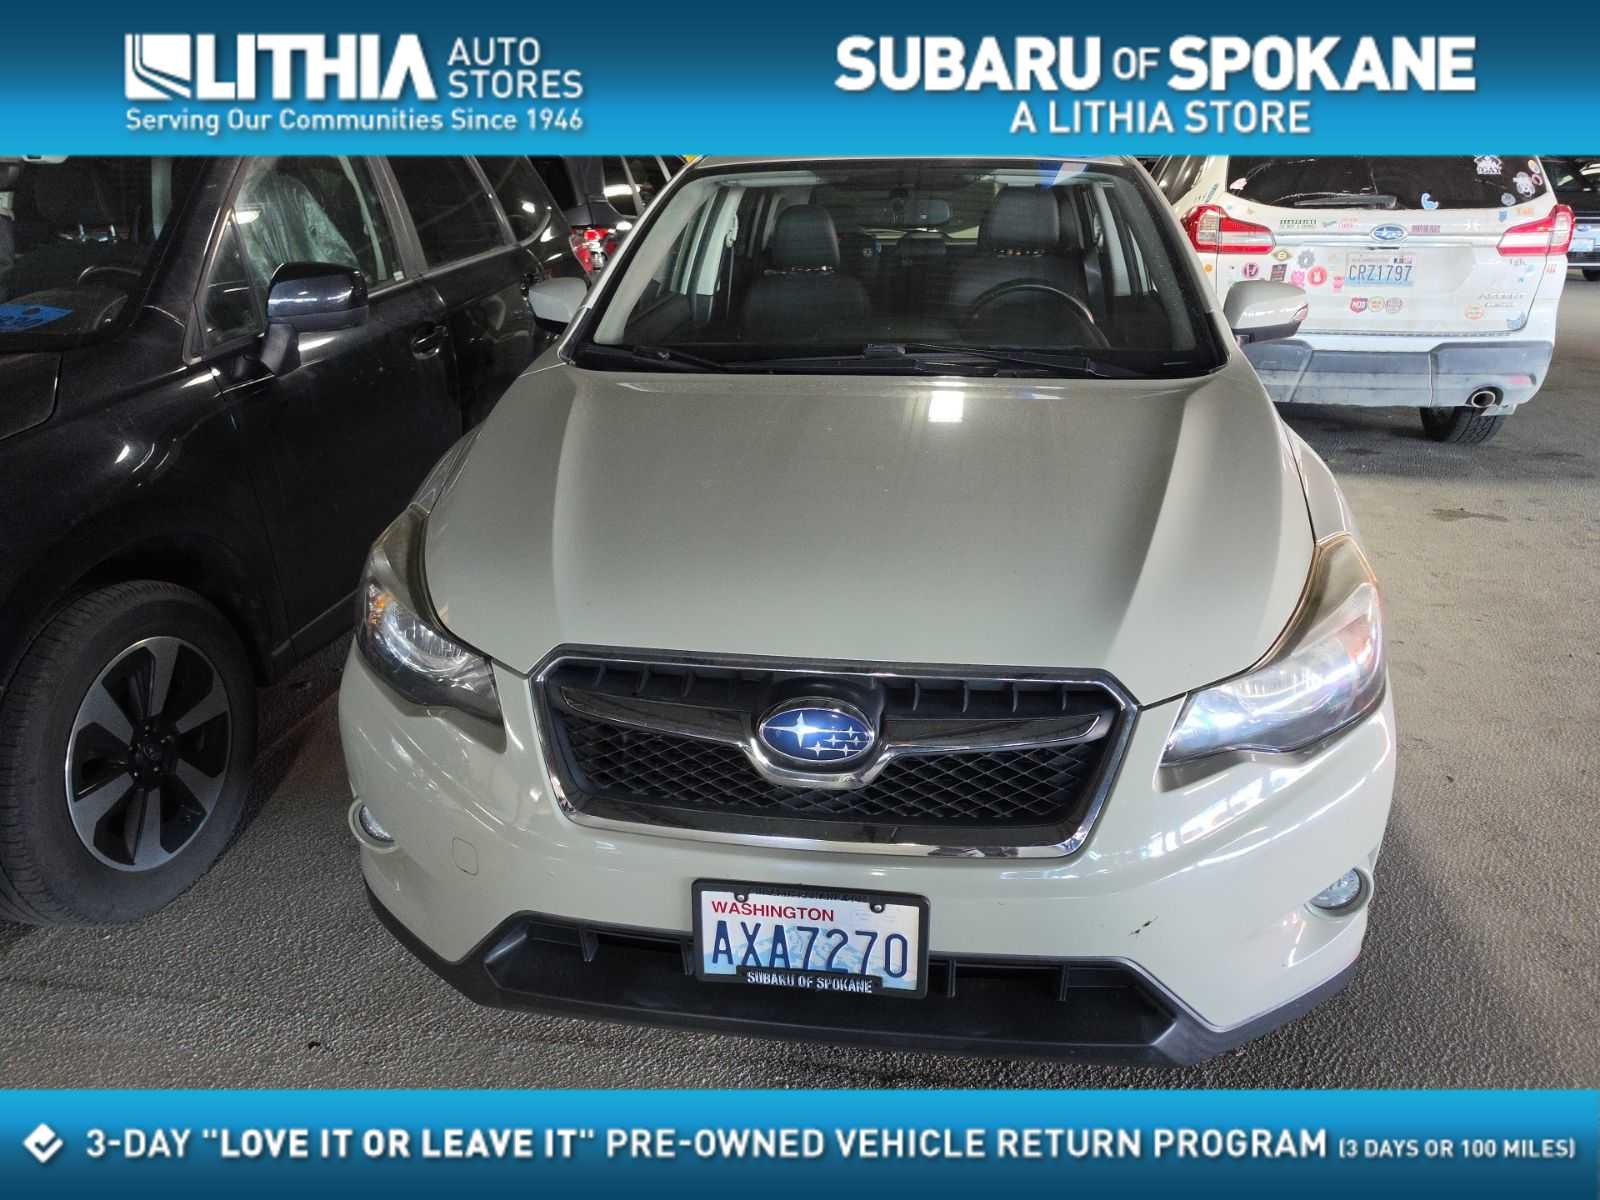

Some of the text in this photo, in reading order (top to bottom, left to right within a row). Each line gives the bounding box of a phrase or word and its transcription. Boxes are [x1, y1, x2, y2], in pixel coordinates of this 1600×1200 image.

[1349, 264, 1412, 282] CRZ1797
[711, 901, 834, 922] WASHINGTON
[712, 920, 908, 978] AXA7270
[747, 971, 873, 994] SUBARU OF SPOKANE
